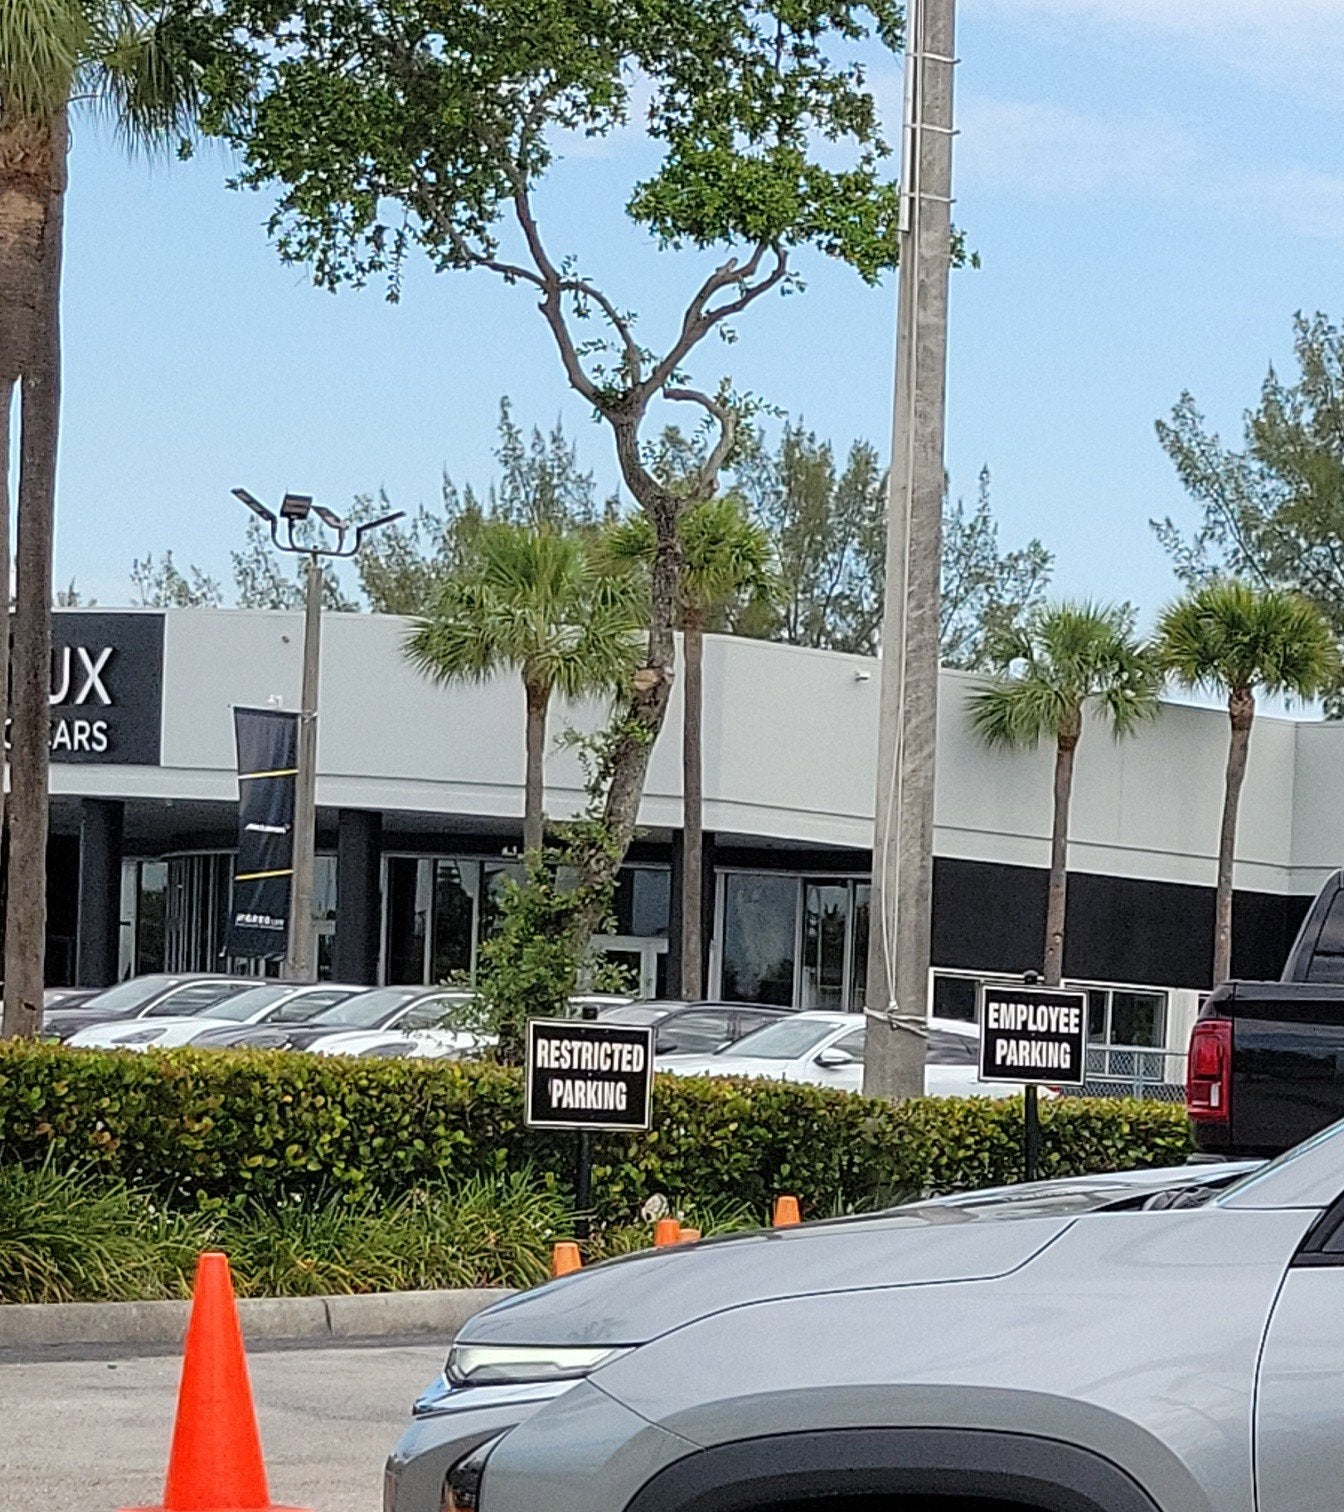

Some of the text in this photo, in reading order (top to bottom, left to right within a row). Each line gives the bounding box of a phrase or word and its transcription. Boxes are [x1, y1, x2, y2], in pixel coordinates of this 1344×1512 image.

[48, 646, 114, 706] UX
[48, 718, 108, 752] ARS
[987, 1002, 1080, 1034] EMPLOYEE
[536, 1038, 645, 1073] RESTRICTED
[995, 1038, 1071, 1070] PARKING
[550, 1078, 628, 1111] PARKING
